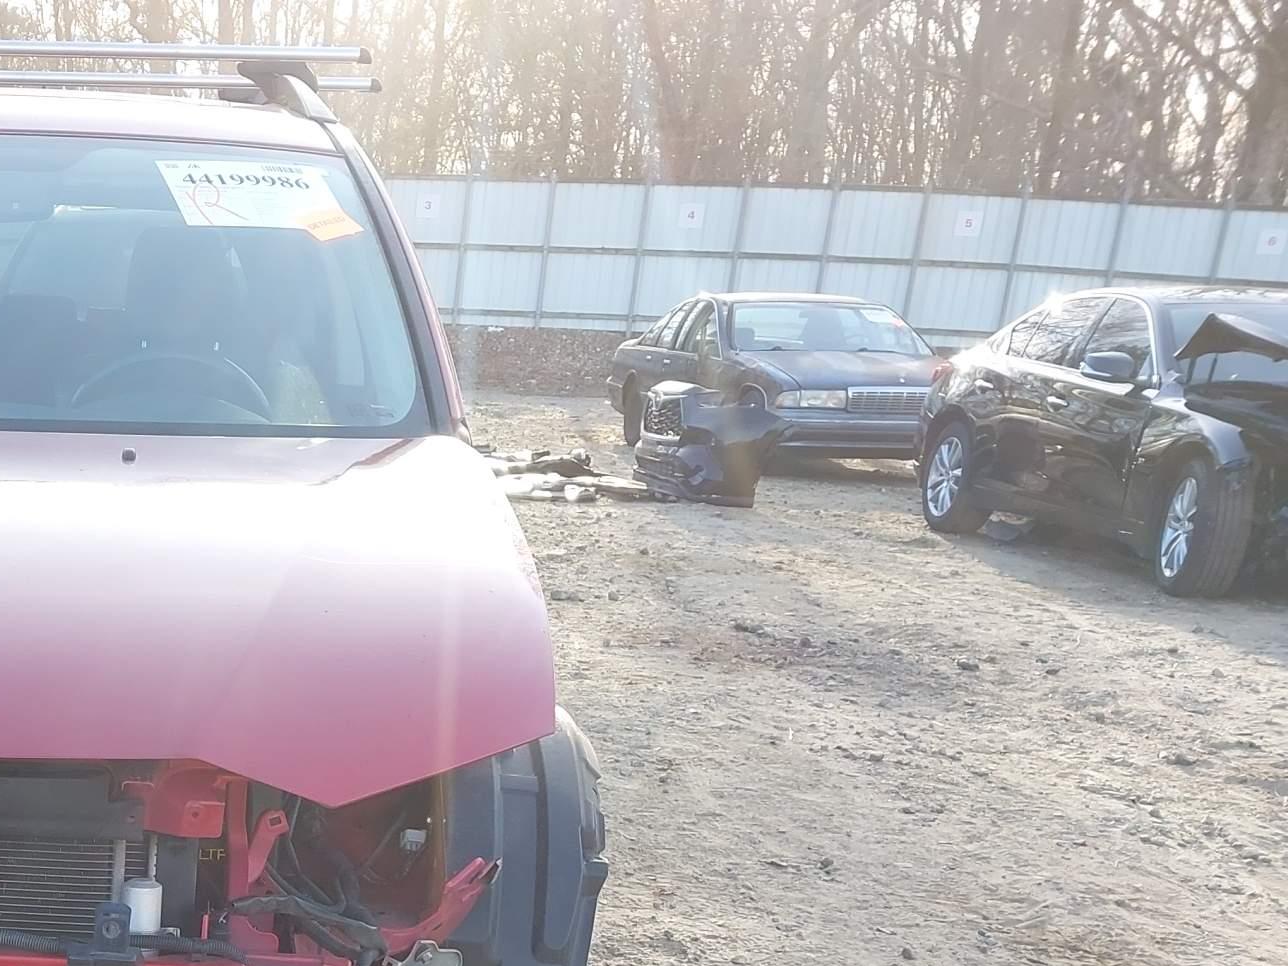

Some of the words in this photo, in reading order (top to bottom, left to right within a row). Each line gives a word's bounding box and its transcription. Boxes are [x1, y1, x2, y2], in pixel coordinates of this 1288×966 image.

[182, 172, 310, 190] 44199986
[423, 200, 433, 210] 3
[687, 210, 696, 220] 4
[964, 218, 974, 228] 5
[1267, 236, 1277, 246] 6
